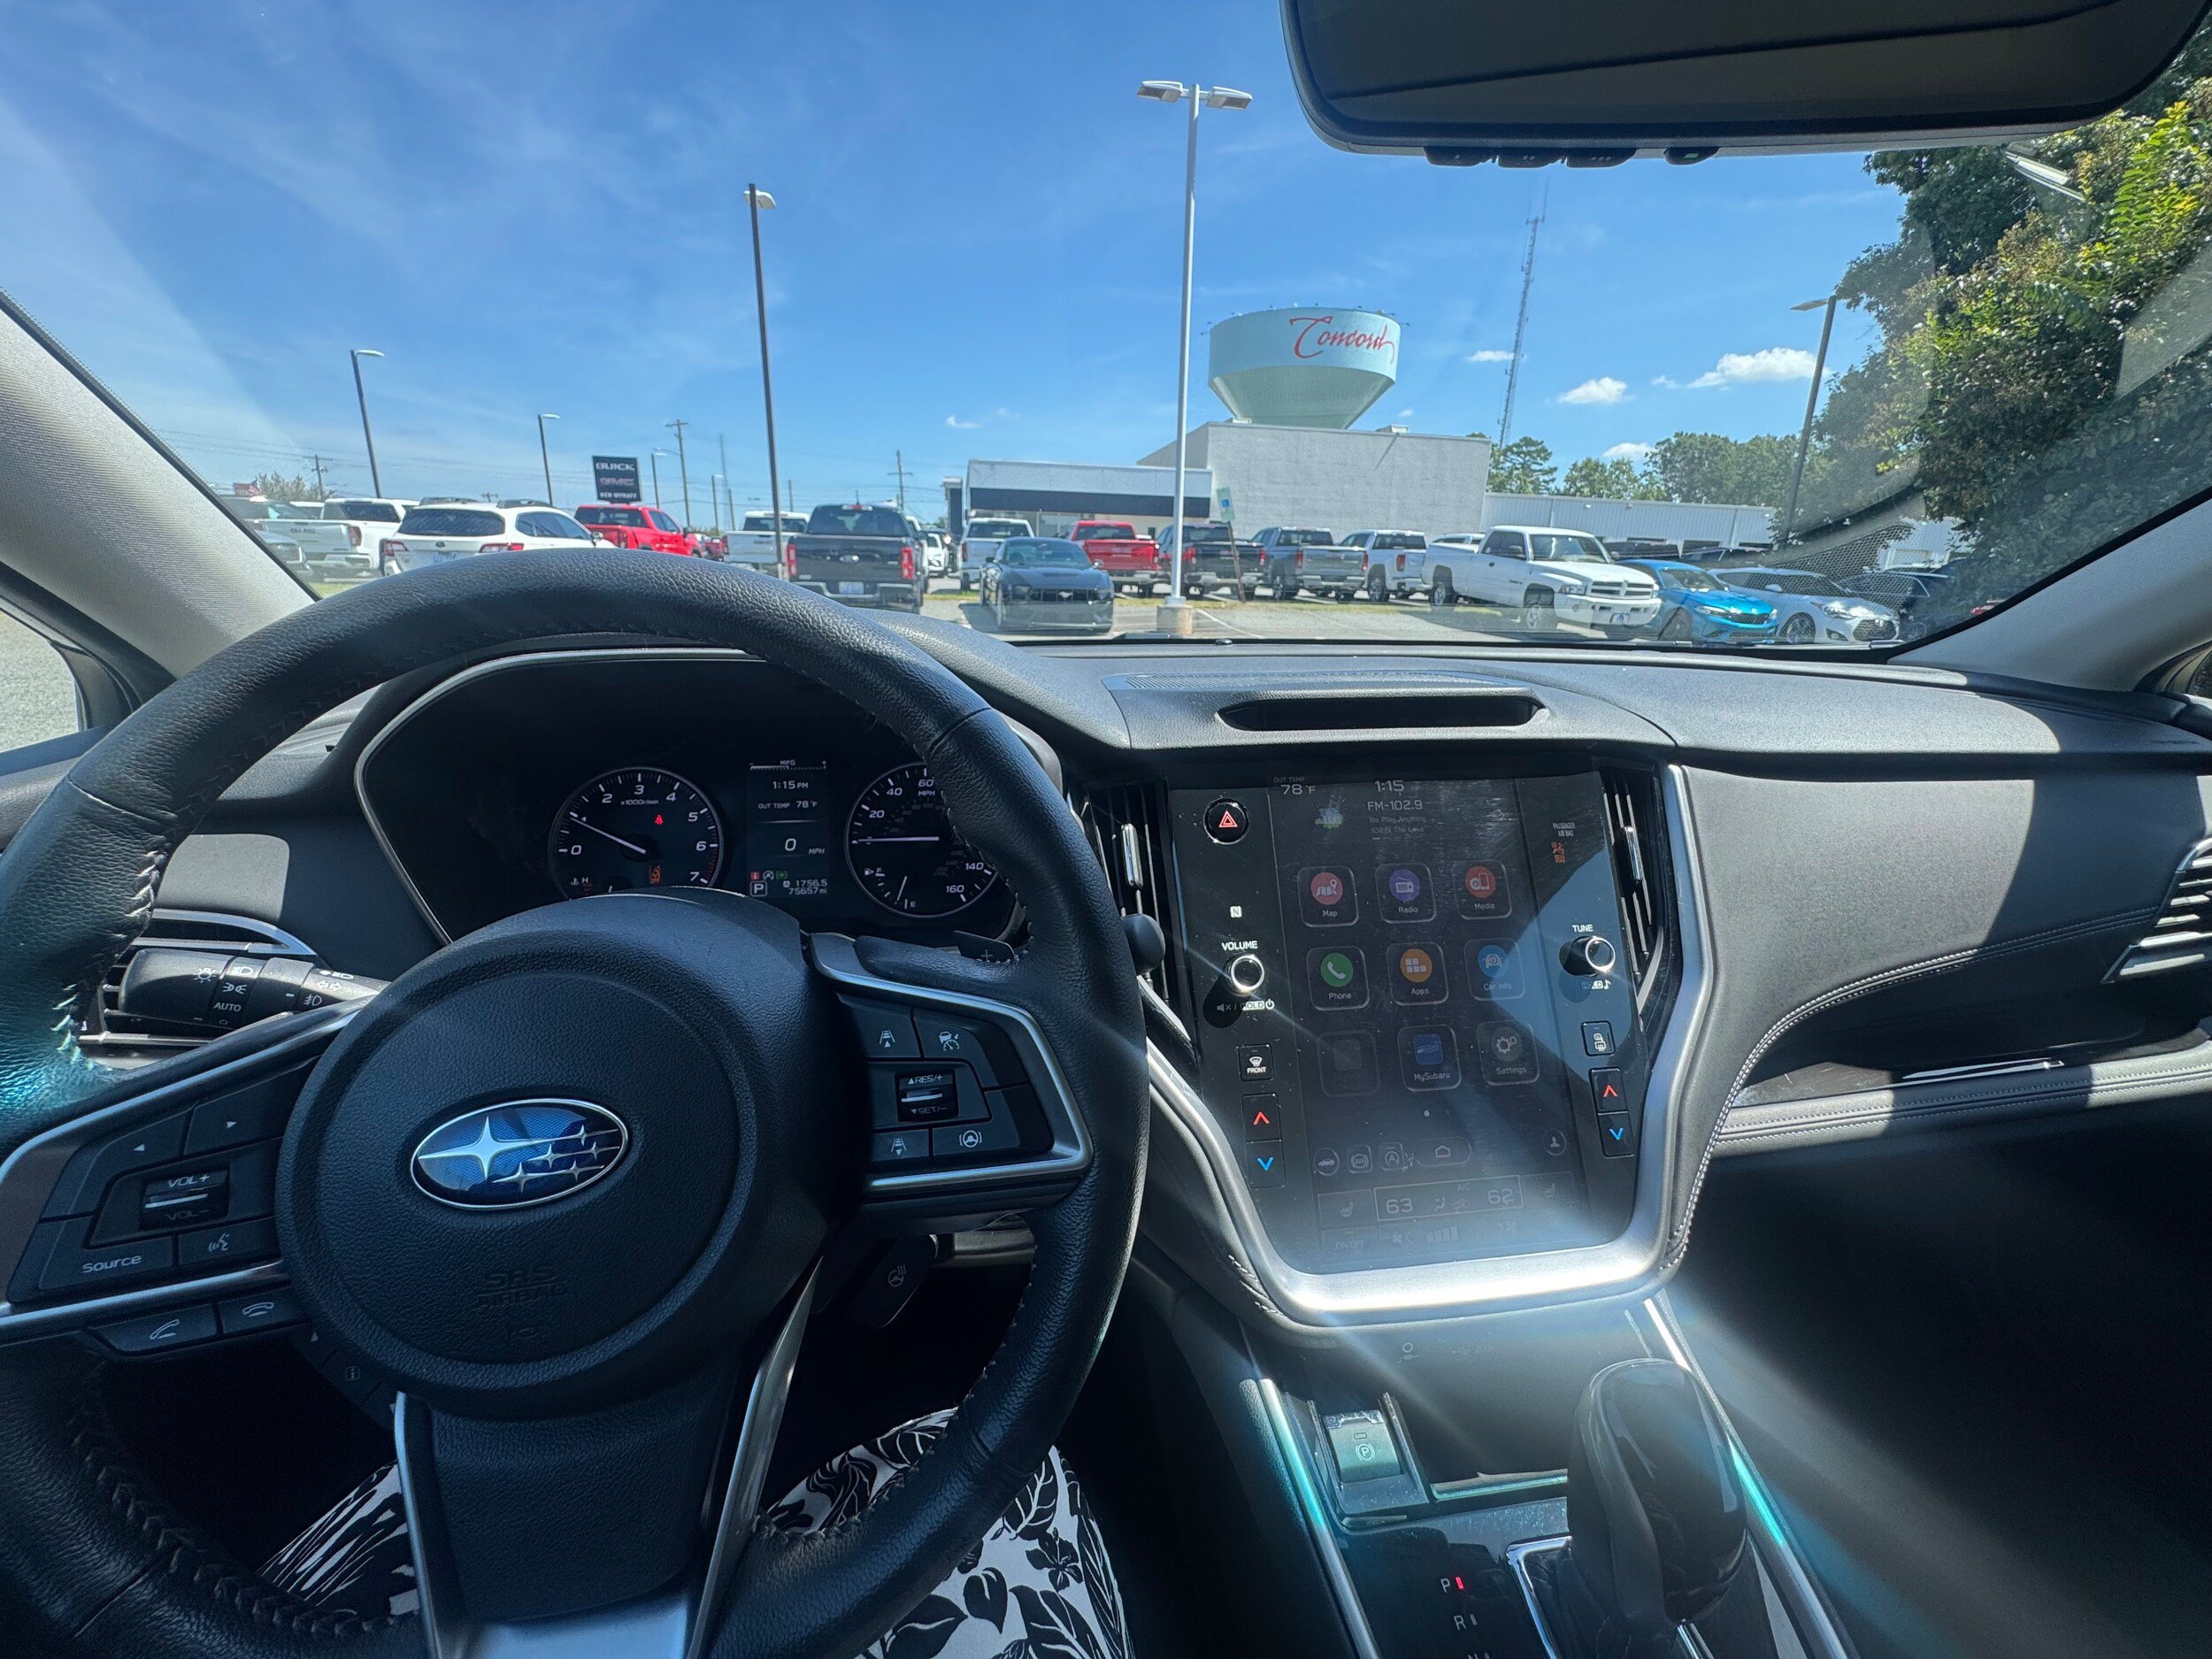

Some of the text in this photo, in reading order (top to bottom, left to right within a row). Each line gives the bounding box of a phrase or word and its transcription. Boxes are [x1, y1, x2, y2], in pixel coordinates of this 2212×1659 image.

[1289, 316, 1395, 364] Concord
[595, 462, 636, 472] BUICK
[772, 780, 795, 789] 1:15
[1281, 784, 1303, 795] 78
[1374, 780, 1405, 792] 1:15
[634, 785, 644, 795] 3
[602, 794, 612, 803] 2
[666, 792, 676, 802] 4
[1367, 799, 1423, 811] FM-102.9
[687, 812, 698, 822] 5
[696, 841, 707, 851] 6
[785, 838, 796, 851] 0
[571, 845, 582, 856] 0
[965, 862, 984, 871] 140
[690, 872, 700, 881] 7
[796, 879, 827, 887] 1756.5
[1571, 924, 1594, 933] TUNE
[1221, 941, 1258, 951] VOLUME
[213, 1002, 242, 1012] AUTO
[1495, 1066, 1527, 1075] Settings
[1414, 1071, 1451, 1082] MySubaru
[1457, 1182, 1471, 1191] A/C
[1486, 1188, 1514, 1205] 62
[1386, 1198, 1414, 1215] 63
[1440, 1578, 1451, 1593] P
[1454, 1615, 1467, 1631] R
